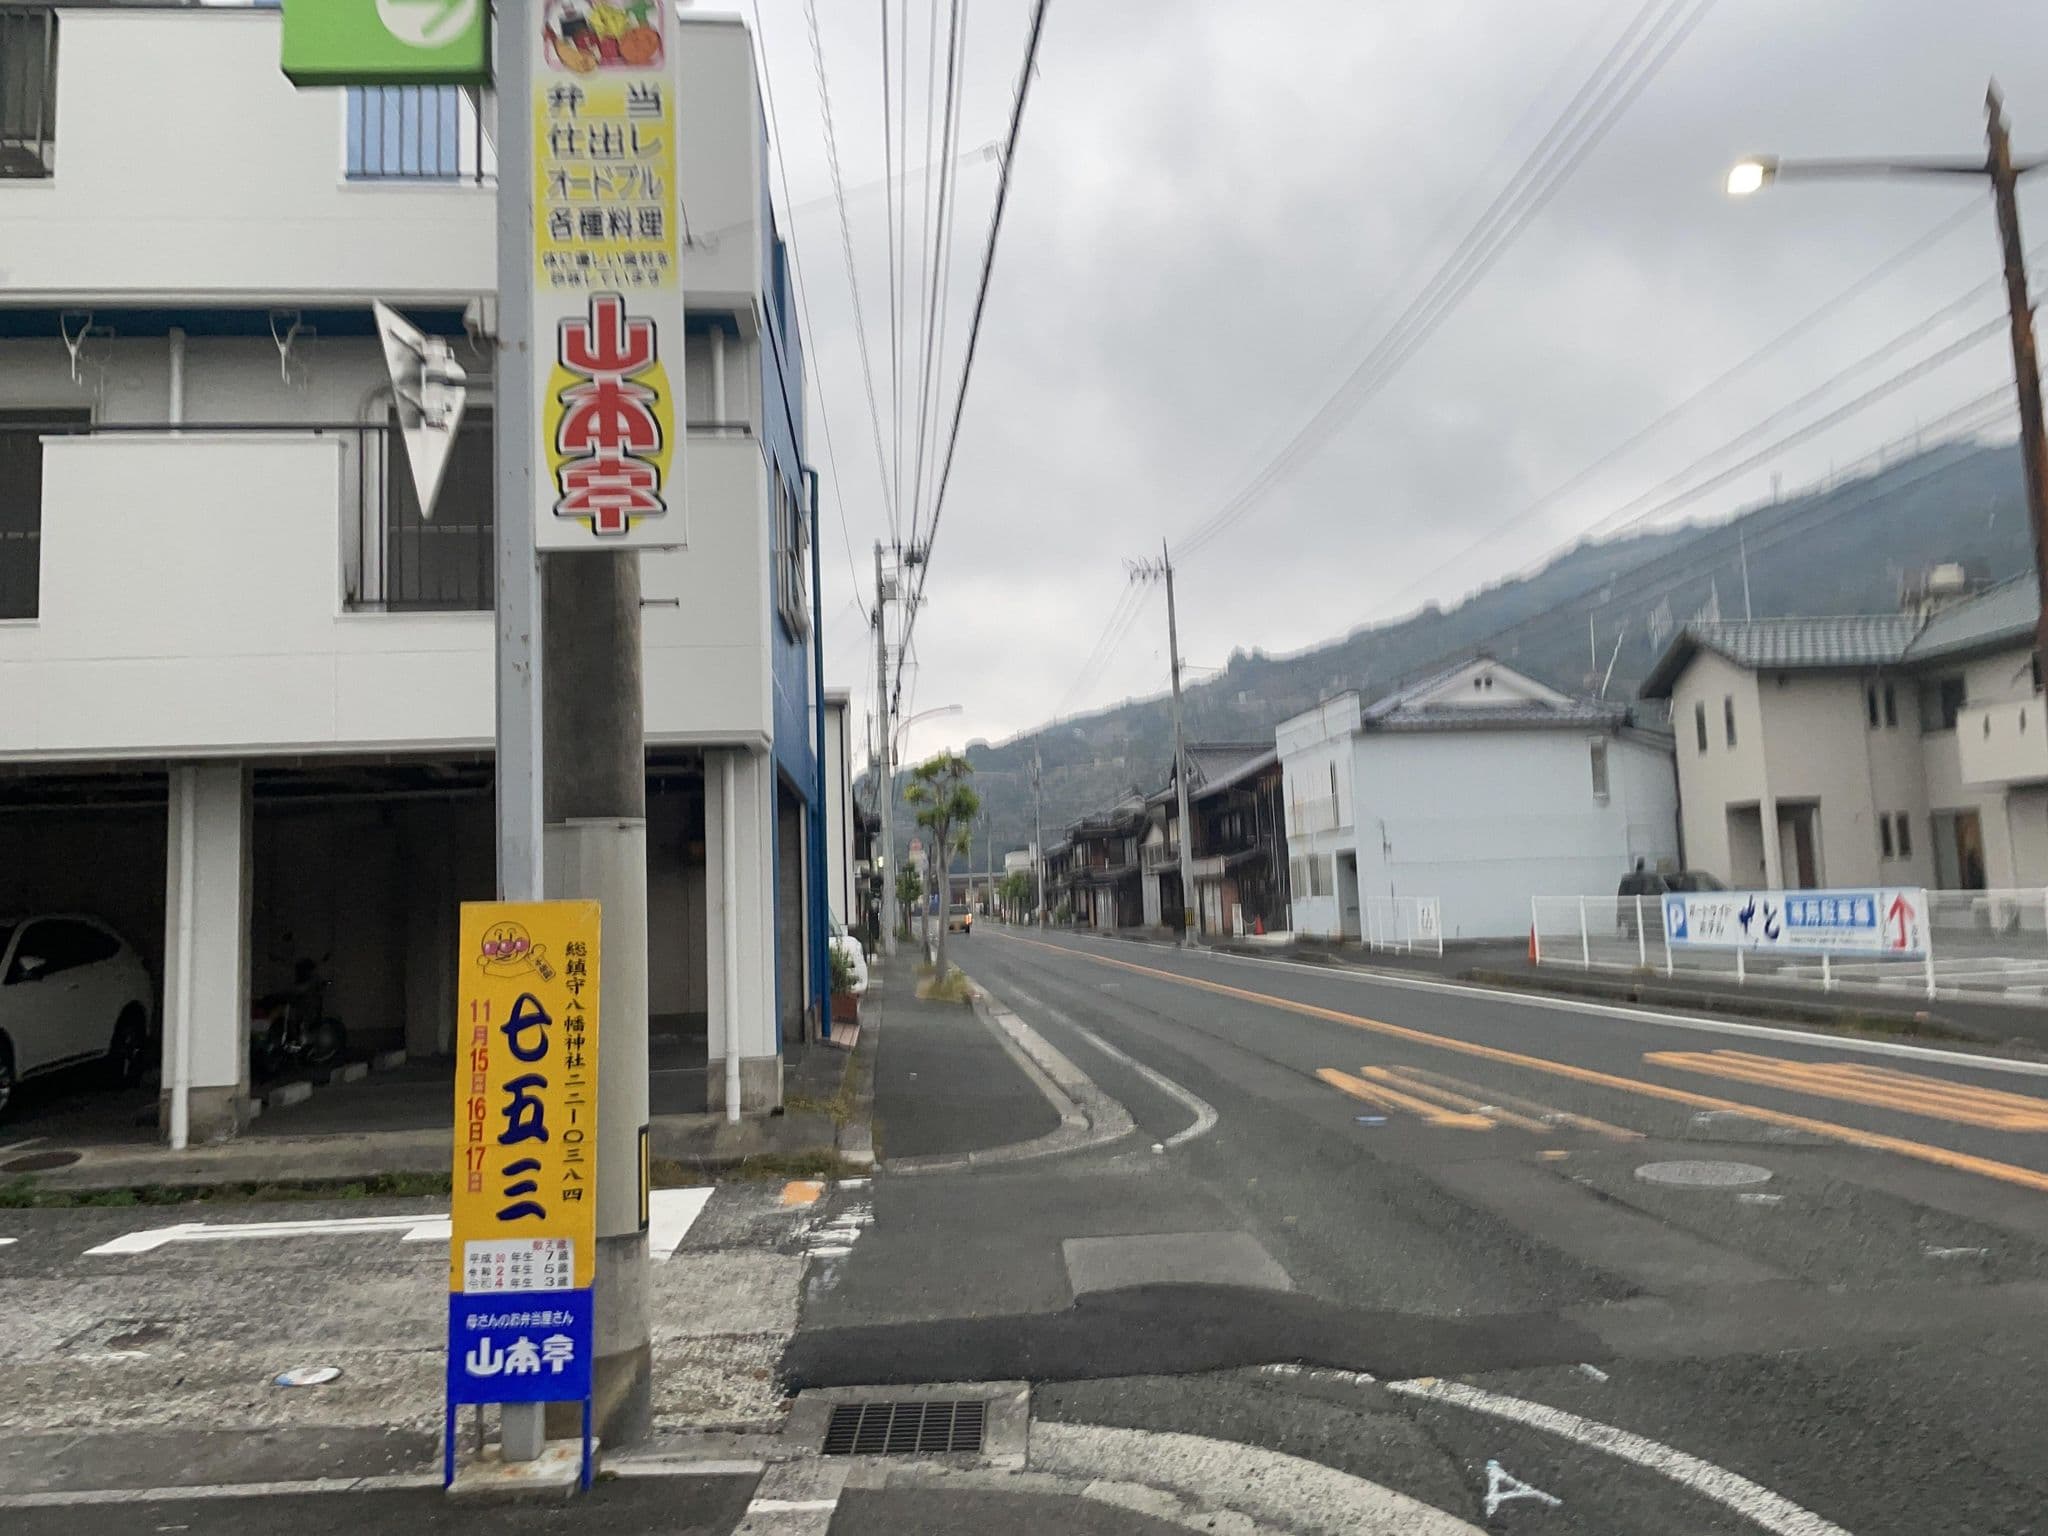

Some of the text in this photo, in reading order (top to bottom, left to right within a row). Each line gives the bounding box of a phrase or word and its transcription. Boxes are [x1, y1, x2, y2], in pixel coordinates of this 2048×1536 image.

[548, 122, 662, 160] 仕出し
[549, 206, 663, 241] 各種料理
[553, 291, 667, 535] 山本亭
[496, 992, 552, 1221] 七五三
[466, 1333, 575, 1376] 山本亭
